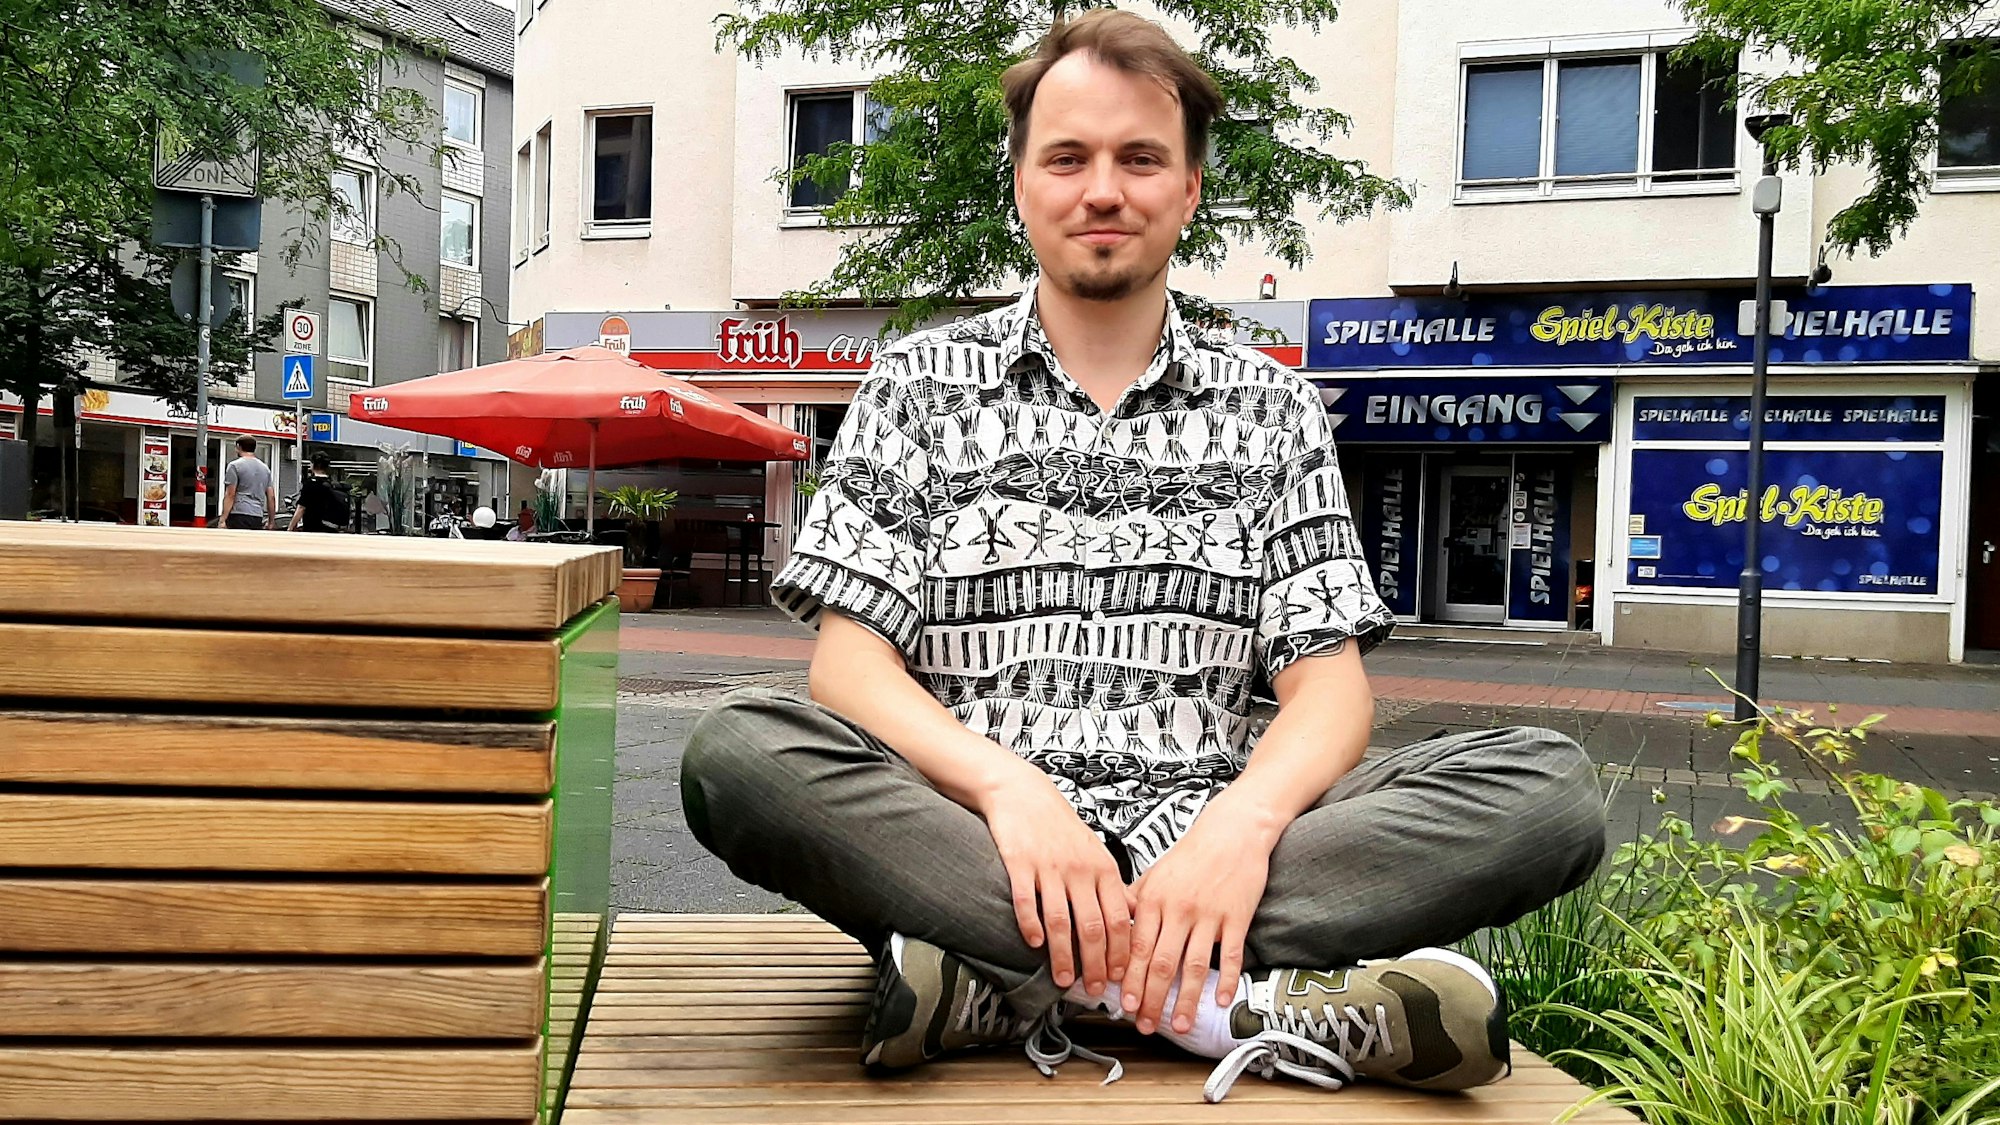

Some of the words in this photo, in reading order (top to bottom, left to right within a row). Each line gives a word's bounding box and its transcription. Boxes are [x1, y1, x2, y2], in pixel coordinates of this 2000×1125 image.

[297, 321, 309, 334] 30
[1324, 318, 1496, 345] SPIELHALLE
[1784, 309, 1953, 338] PIELHALLE
[293, 341, 312, 351] ZONE
[1649, 341, 1674, 355] Da
[1696, 338, 1714, 351] ich
[1366, 394, 1543, 428] EINGANG
[1639, 408, 1729, 423] SPIELHALLE
[1739, 409, 1833, 423] SELHALLE
[1842, 409, 1939, 423] SPIELHALLE
[1379, 468, 1403, 600] SPIELHALLE
[1530, 468, 1555, 605] SPIELHALLE
[1858, 574, 1928, 586] SPIELHALLE
